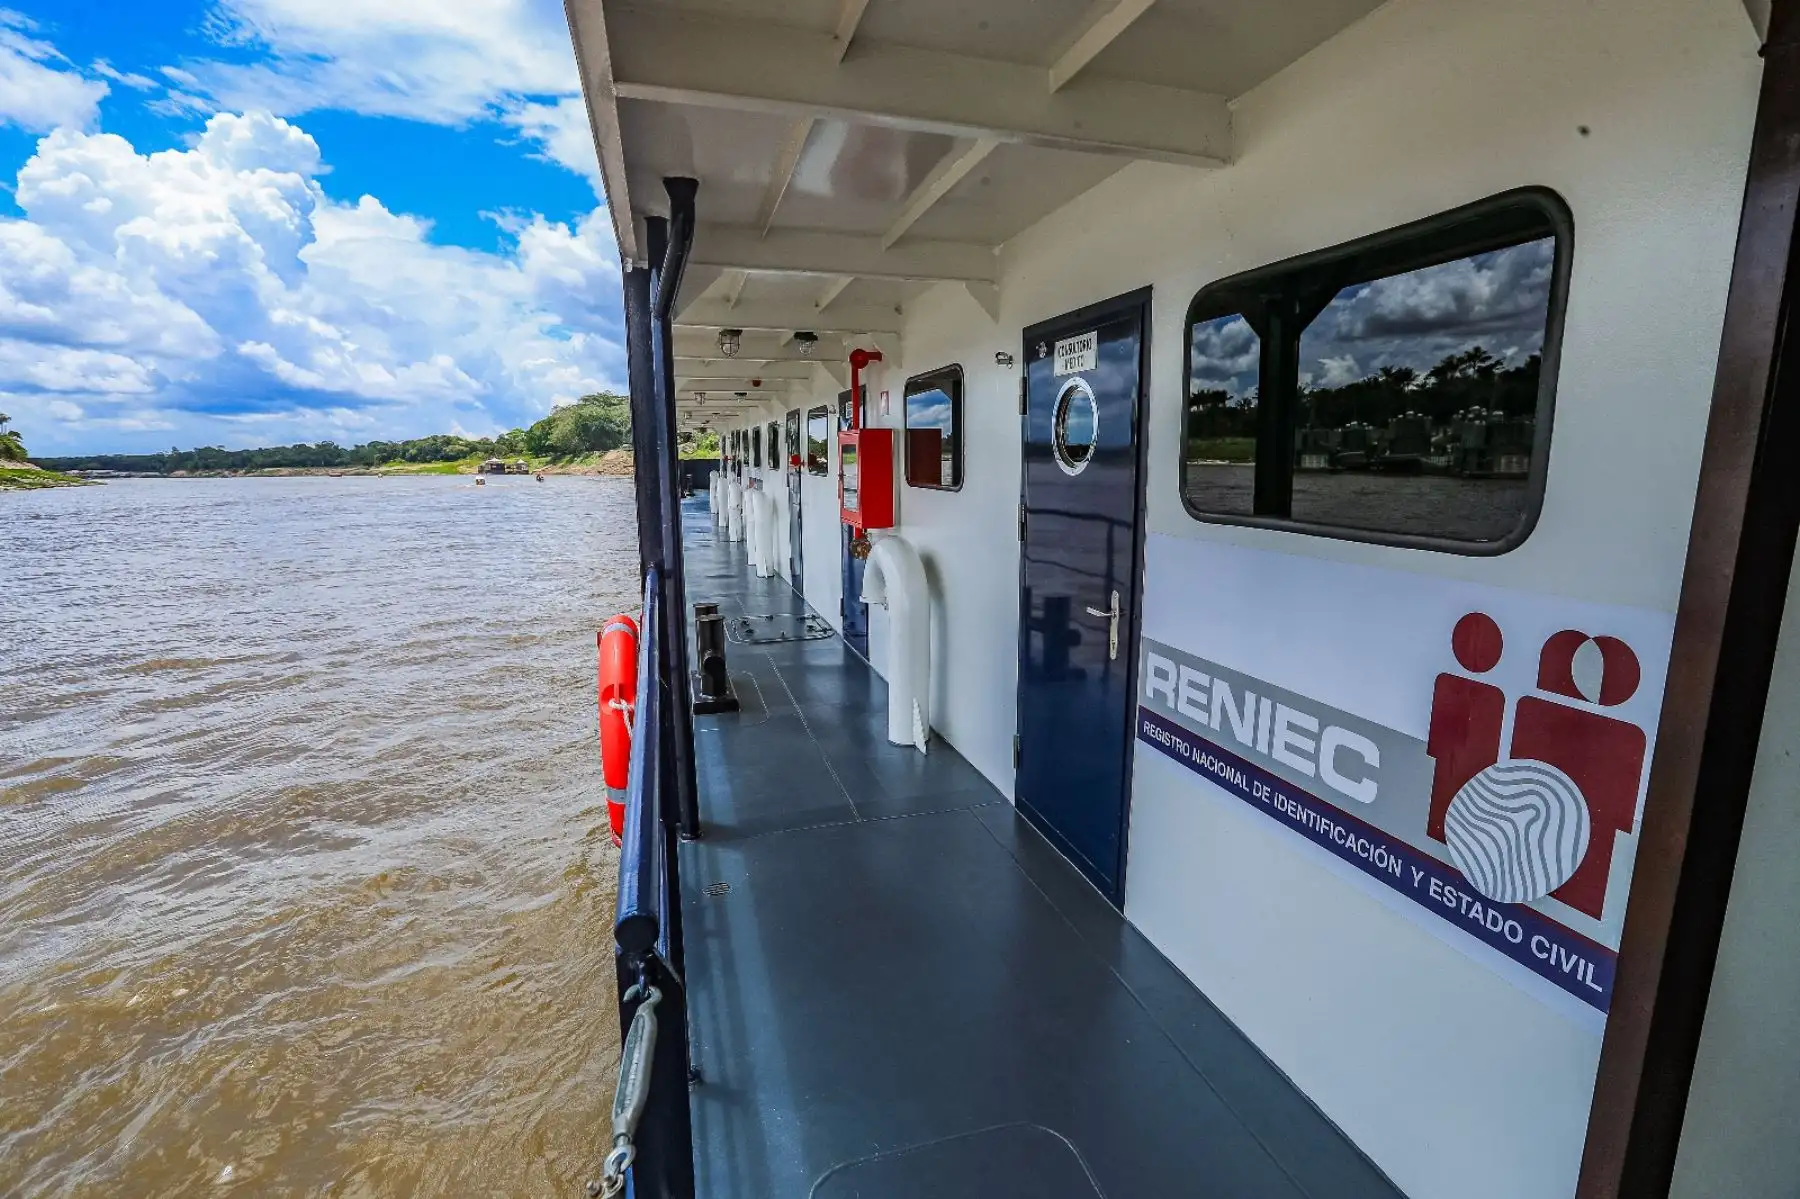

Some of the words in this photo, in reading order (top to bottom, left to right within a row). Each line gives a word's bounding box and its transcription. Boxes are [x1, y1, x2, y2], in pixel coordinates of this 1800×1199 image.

[1146, 652, 1380, 804] RENIEC
[1143, 720, 1190, 757] REGISTRO
[1192, 746, 1249, 792] NACIONAL
[1252, 780, 1271, 804] DE
[1273, 792, 1402, 877] IDENTIFICACIÓN
[1410, 865, 1425, 888] Y
[1429, 876, 1523, 944] ESTADO
[1530, 935, 1603, 993] CIVIL
